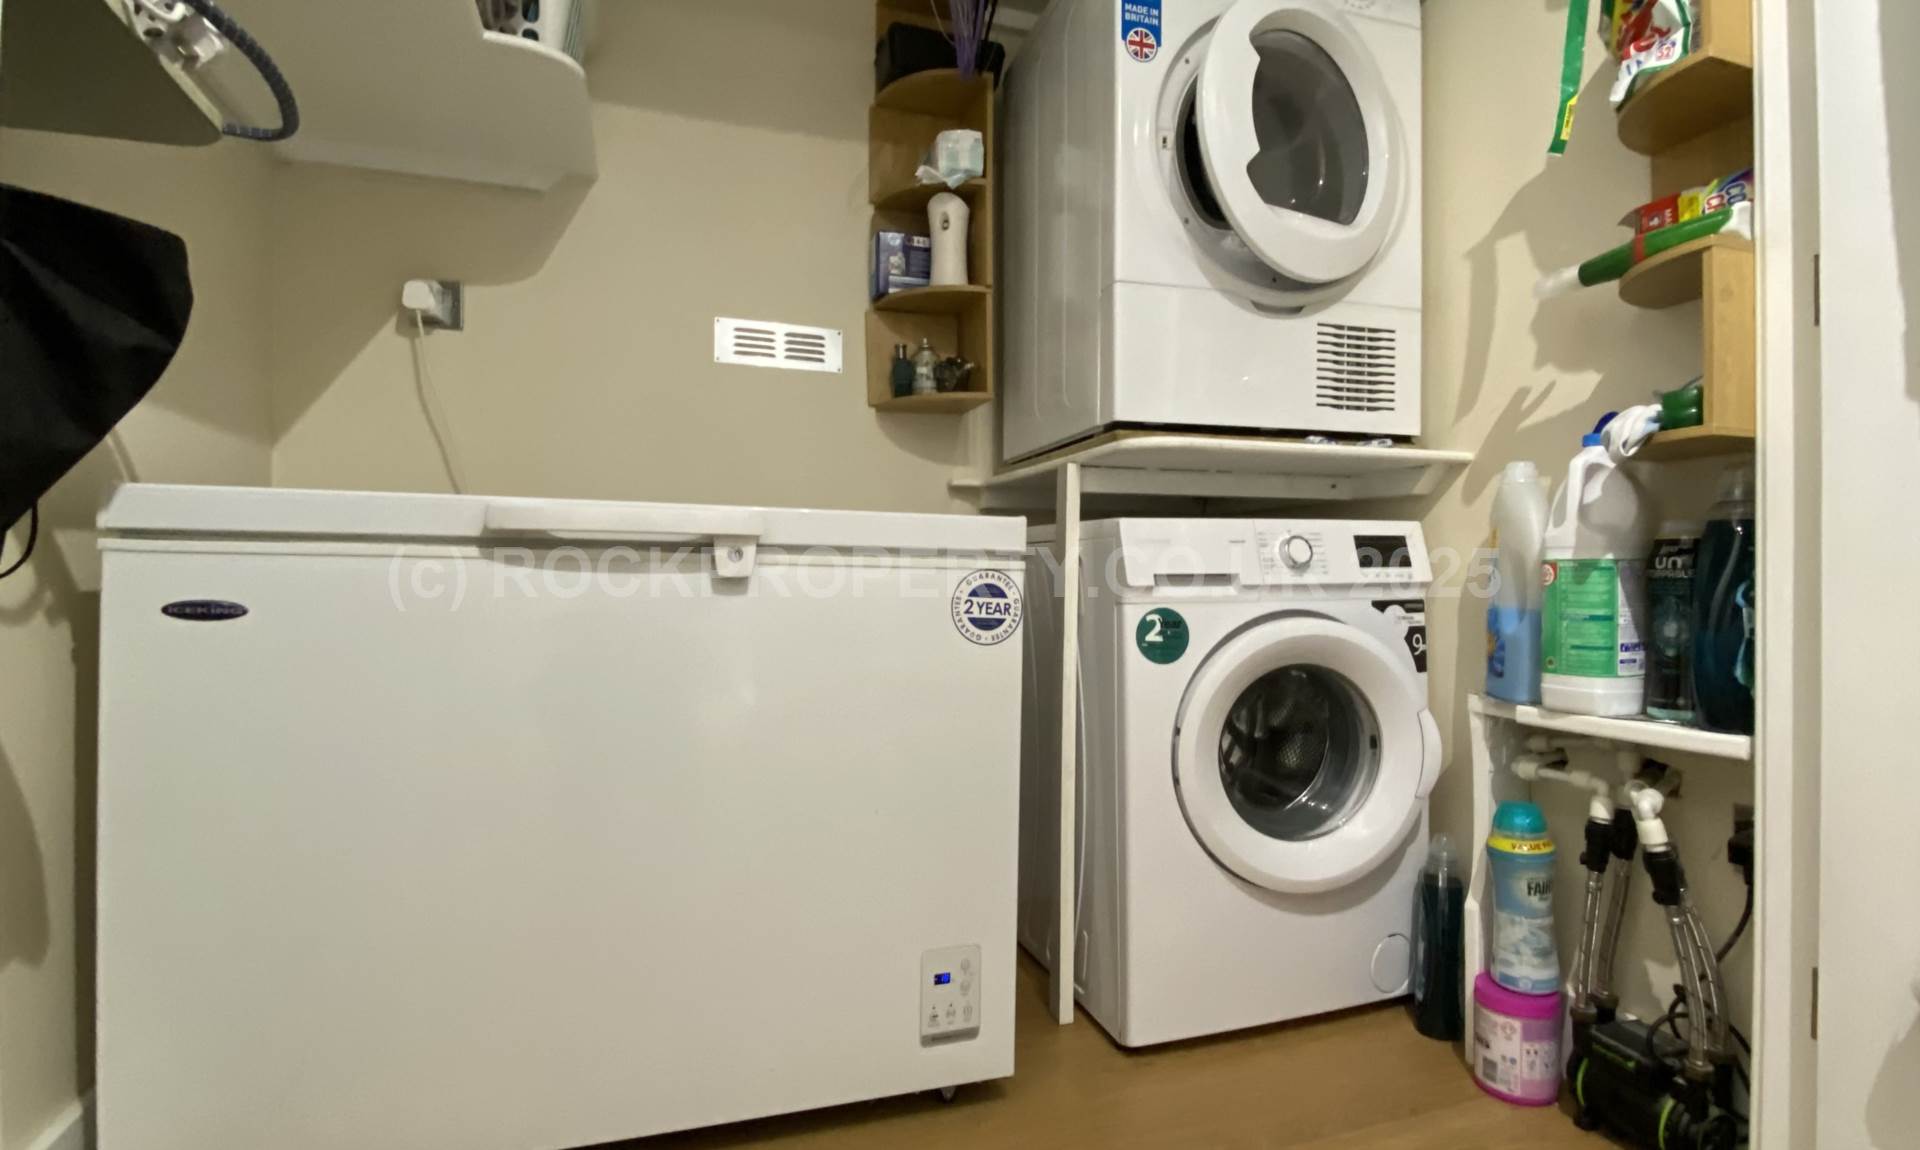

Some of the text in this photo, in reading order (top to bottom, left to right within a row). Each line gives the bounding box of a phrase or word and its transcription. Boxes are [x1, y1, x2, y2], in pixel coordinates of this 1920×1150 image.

[1124, 3, 1159, 17] MADE IN
[1124, 12, 1159, 26] BRITAIN
[963, 599, 1012, 616] 2 YEAR
[1144, 613, 1164, 642] 2
[1412, 633, 1423, 656] 9
